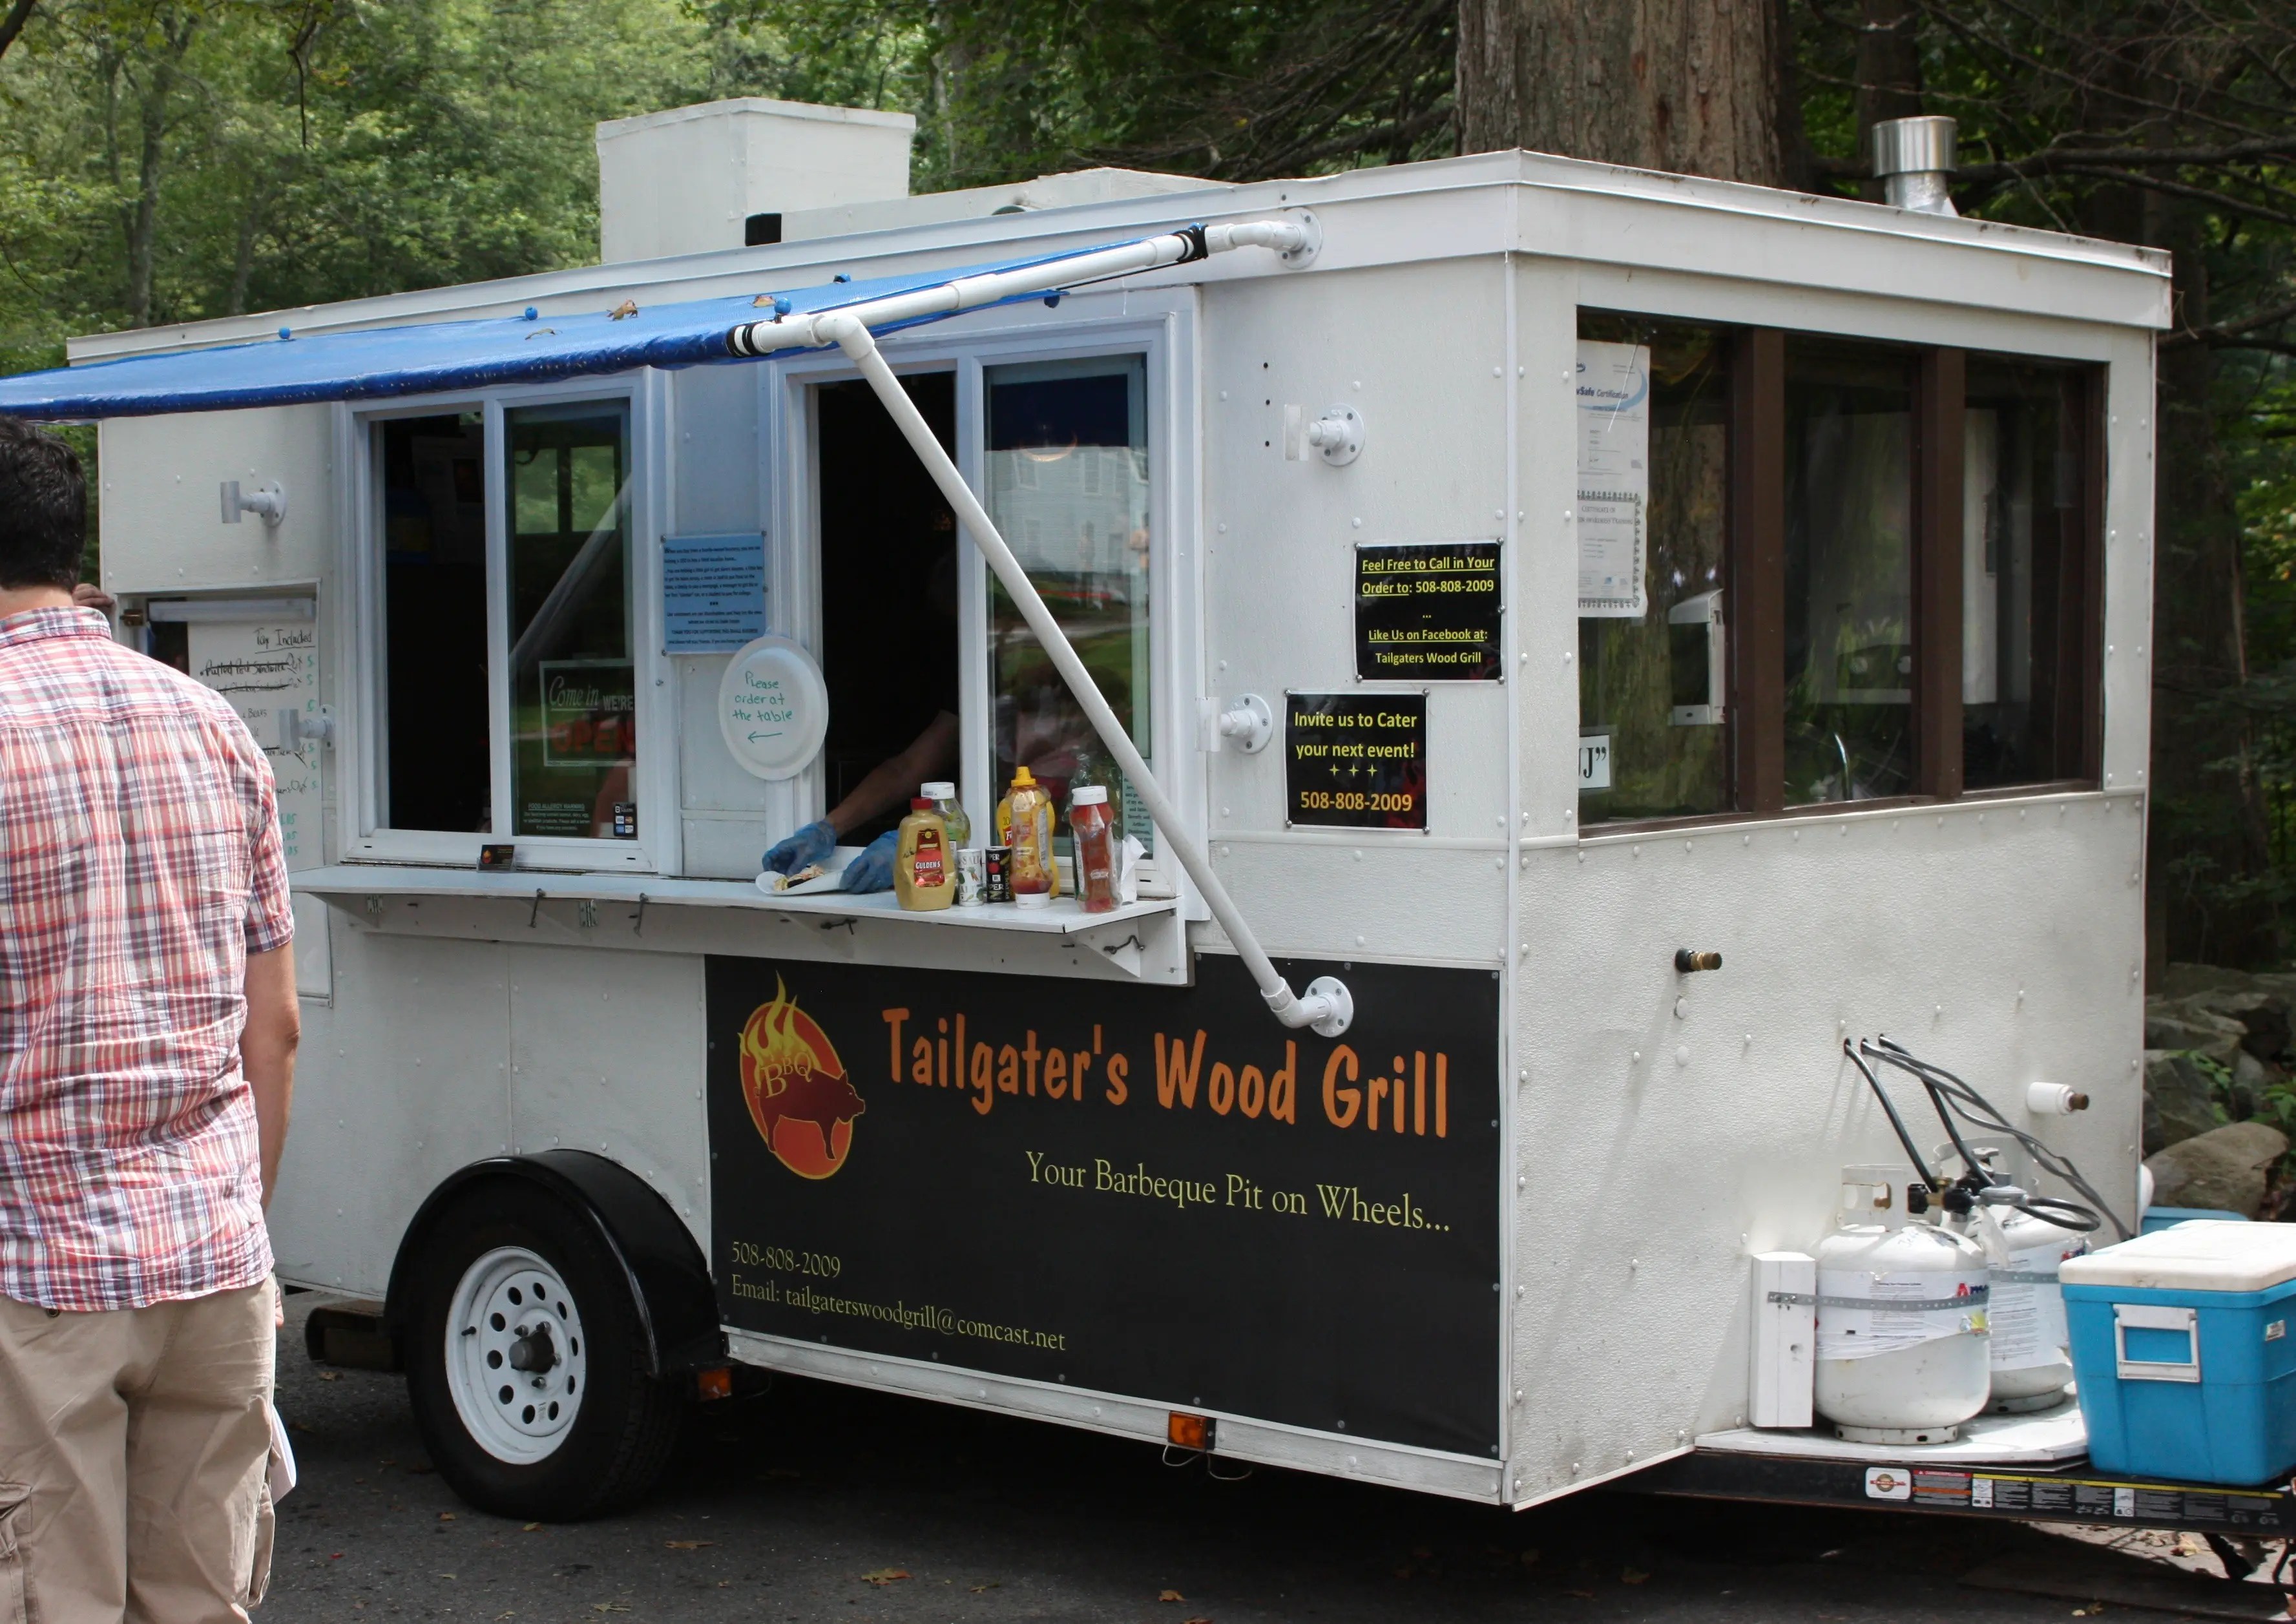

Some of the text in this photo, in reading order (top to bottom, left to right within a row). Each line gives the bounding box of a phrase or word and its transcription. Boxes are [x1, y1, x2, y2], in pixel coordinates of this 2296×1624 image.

[1362, 556, 1494, 570] Feel Free to Call in Your
[1362, 579, 1494, 595] Order to: 508-808-2009
[275, 629, 312, 647] Included
[1368, 629, 1488, 641] Like Us on Facebook at:
[1377, 652, 1481, 666] Tailgaters Wood Grill
[550, 676, 633, 711] Come in WE'RE
[735, 694, 786, 705] order at
[732, 709, 793, 723] the table
[1295, 712, 1417, 727] Invite us to Cater
[552, 720, 635, 753] OPEN
[1296, 743, 1414, 759] your next event!
[1300, 791, 1413, 811] 508-808-2009
[915, 860, 941, 869] GULDEN'S
[760, 1052, 812, 1098] BBQ
[882, 1008, 1448, 1138] Tailgater's Wood Grill
[1027, 1151, 1450, 1232] Your Barbeque Pit on Wheels...
[731, 1241, 841, 1278] 508-808-2009
[731, 1273, 1065, 1351] Email: tailgaterswoodgrill@comcast.net
